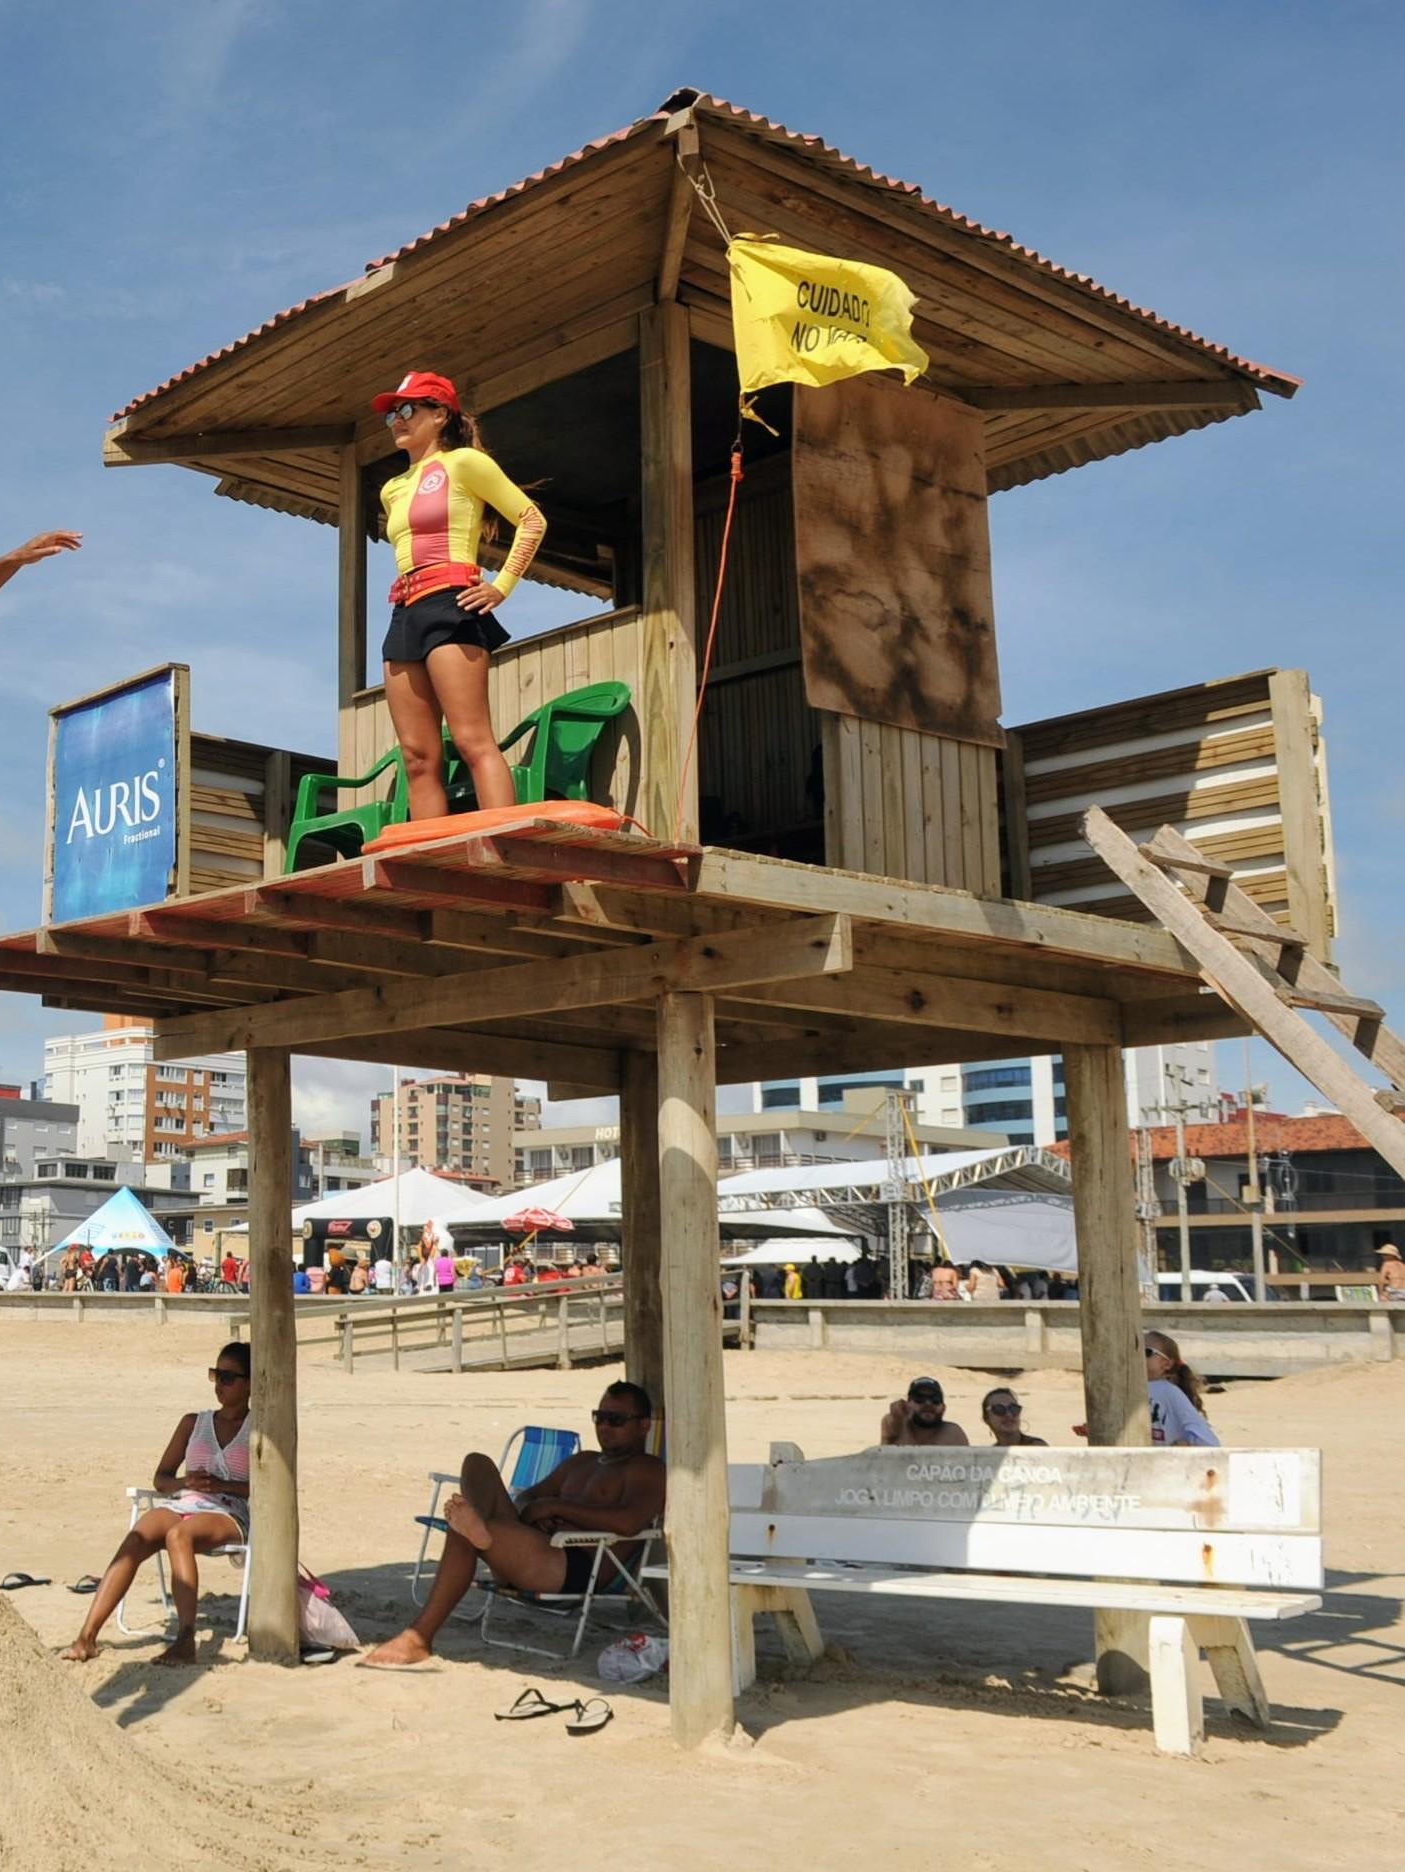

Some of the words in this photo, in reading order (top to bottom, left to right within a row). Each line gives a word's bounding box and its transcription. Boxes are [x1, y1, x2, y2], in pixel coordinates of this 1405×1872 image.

[791, 321, 820, 353] NO
[519, 506, 544, 534] VIDAS
[505, 538, 539, 577] GUARDA
[906, 1463, 966, 1481] CAPÃO
[970, 1464, 994, 1482] DA
[998, 1465, 1064, 1484] CANOA
[835, 1488, 880, 1506] JOGA
[884, 1489, 933, 1508] LIMPO
[938, 1490, 977, 1509] COM
